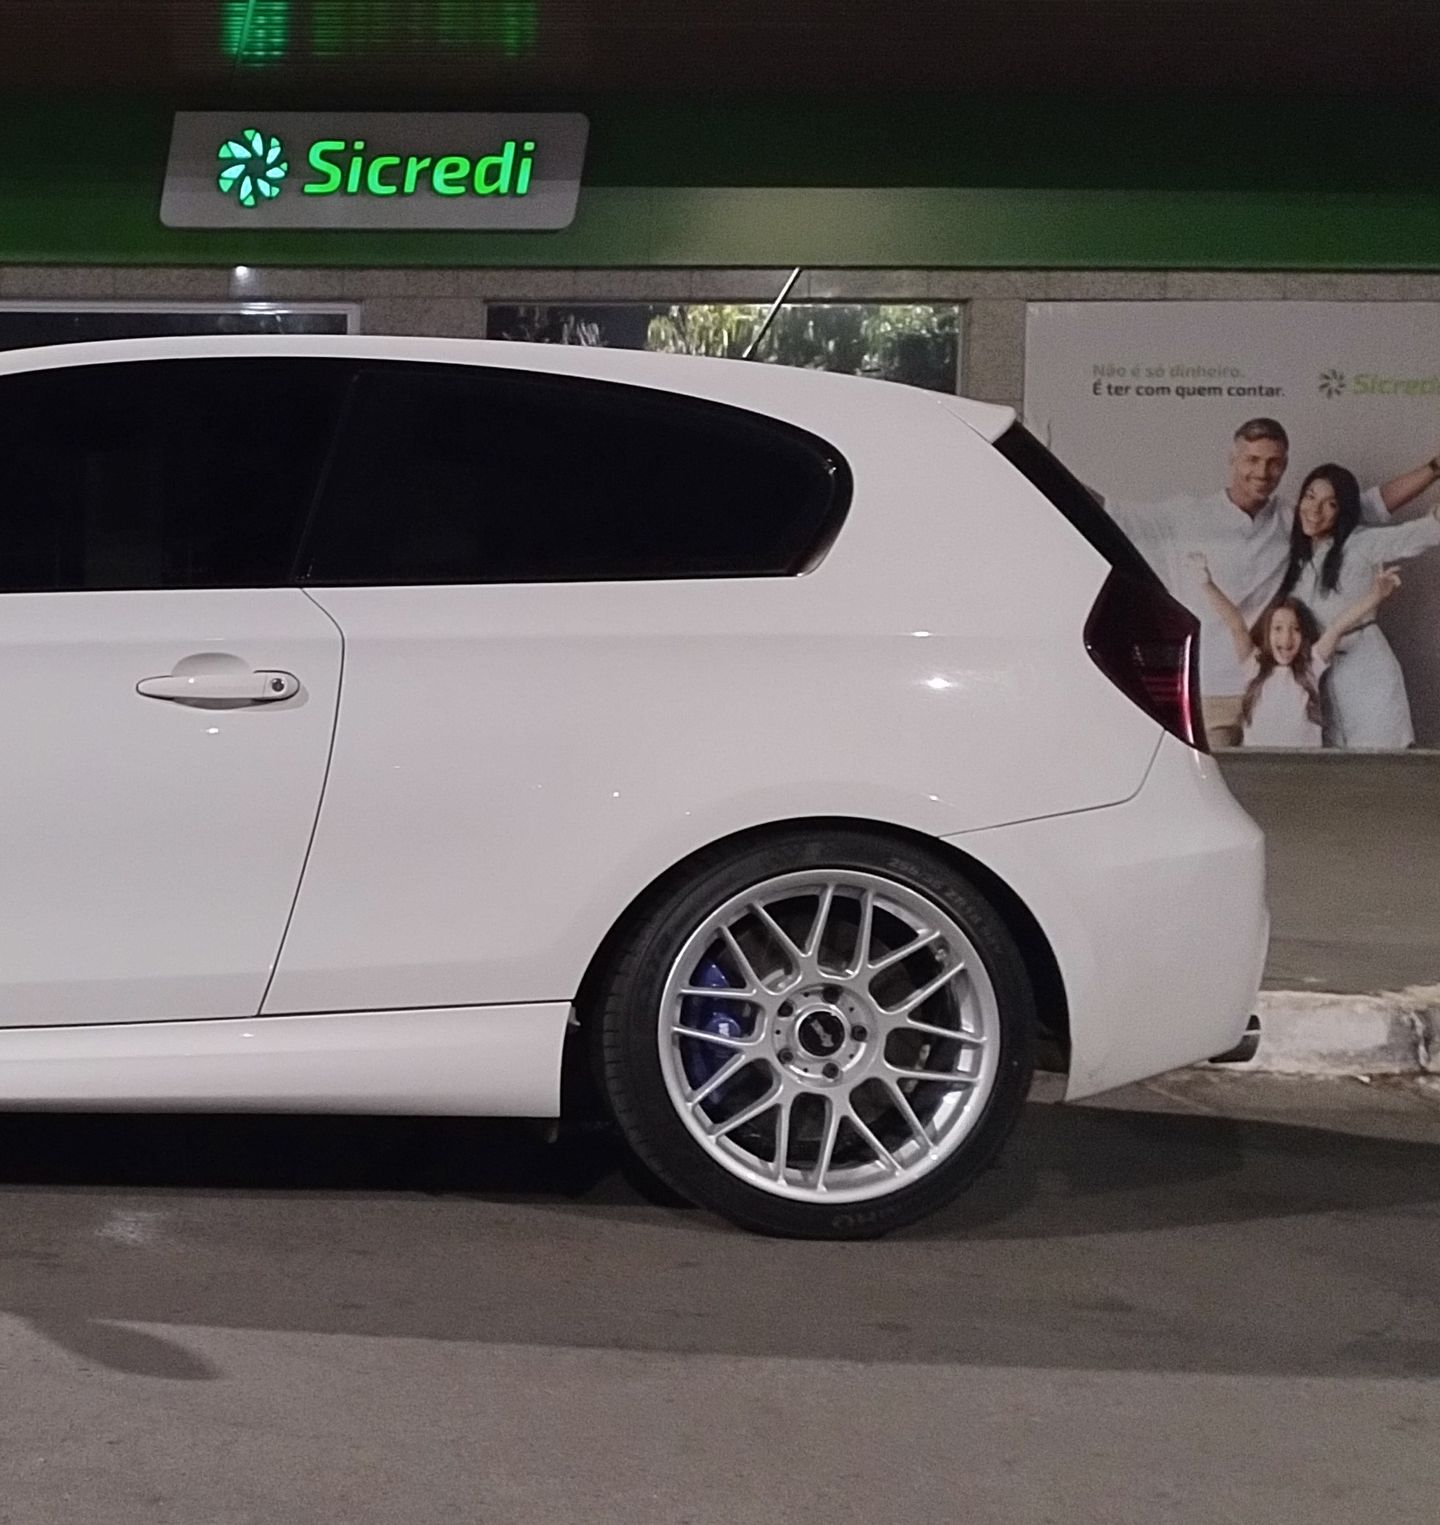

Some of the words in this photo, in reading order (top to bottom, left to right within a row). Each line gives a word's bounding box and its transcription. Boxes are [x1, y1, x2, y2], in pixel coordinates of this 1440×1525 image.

[303, 140, 536, 195] Sicredi
[1092, 379, 1102, 396] É
[1106, 384, 1131, 397] ter
[1135, 385, 1171, 397] com
[1175, 385, 1223, 400] quem
[1227, 384, 1286, 398] contar.
[1352, 373, 1440, 395] Sicred
